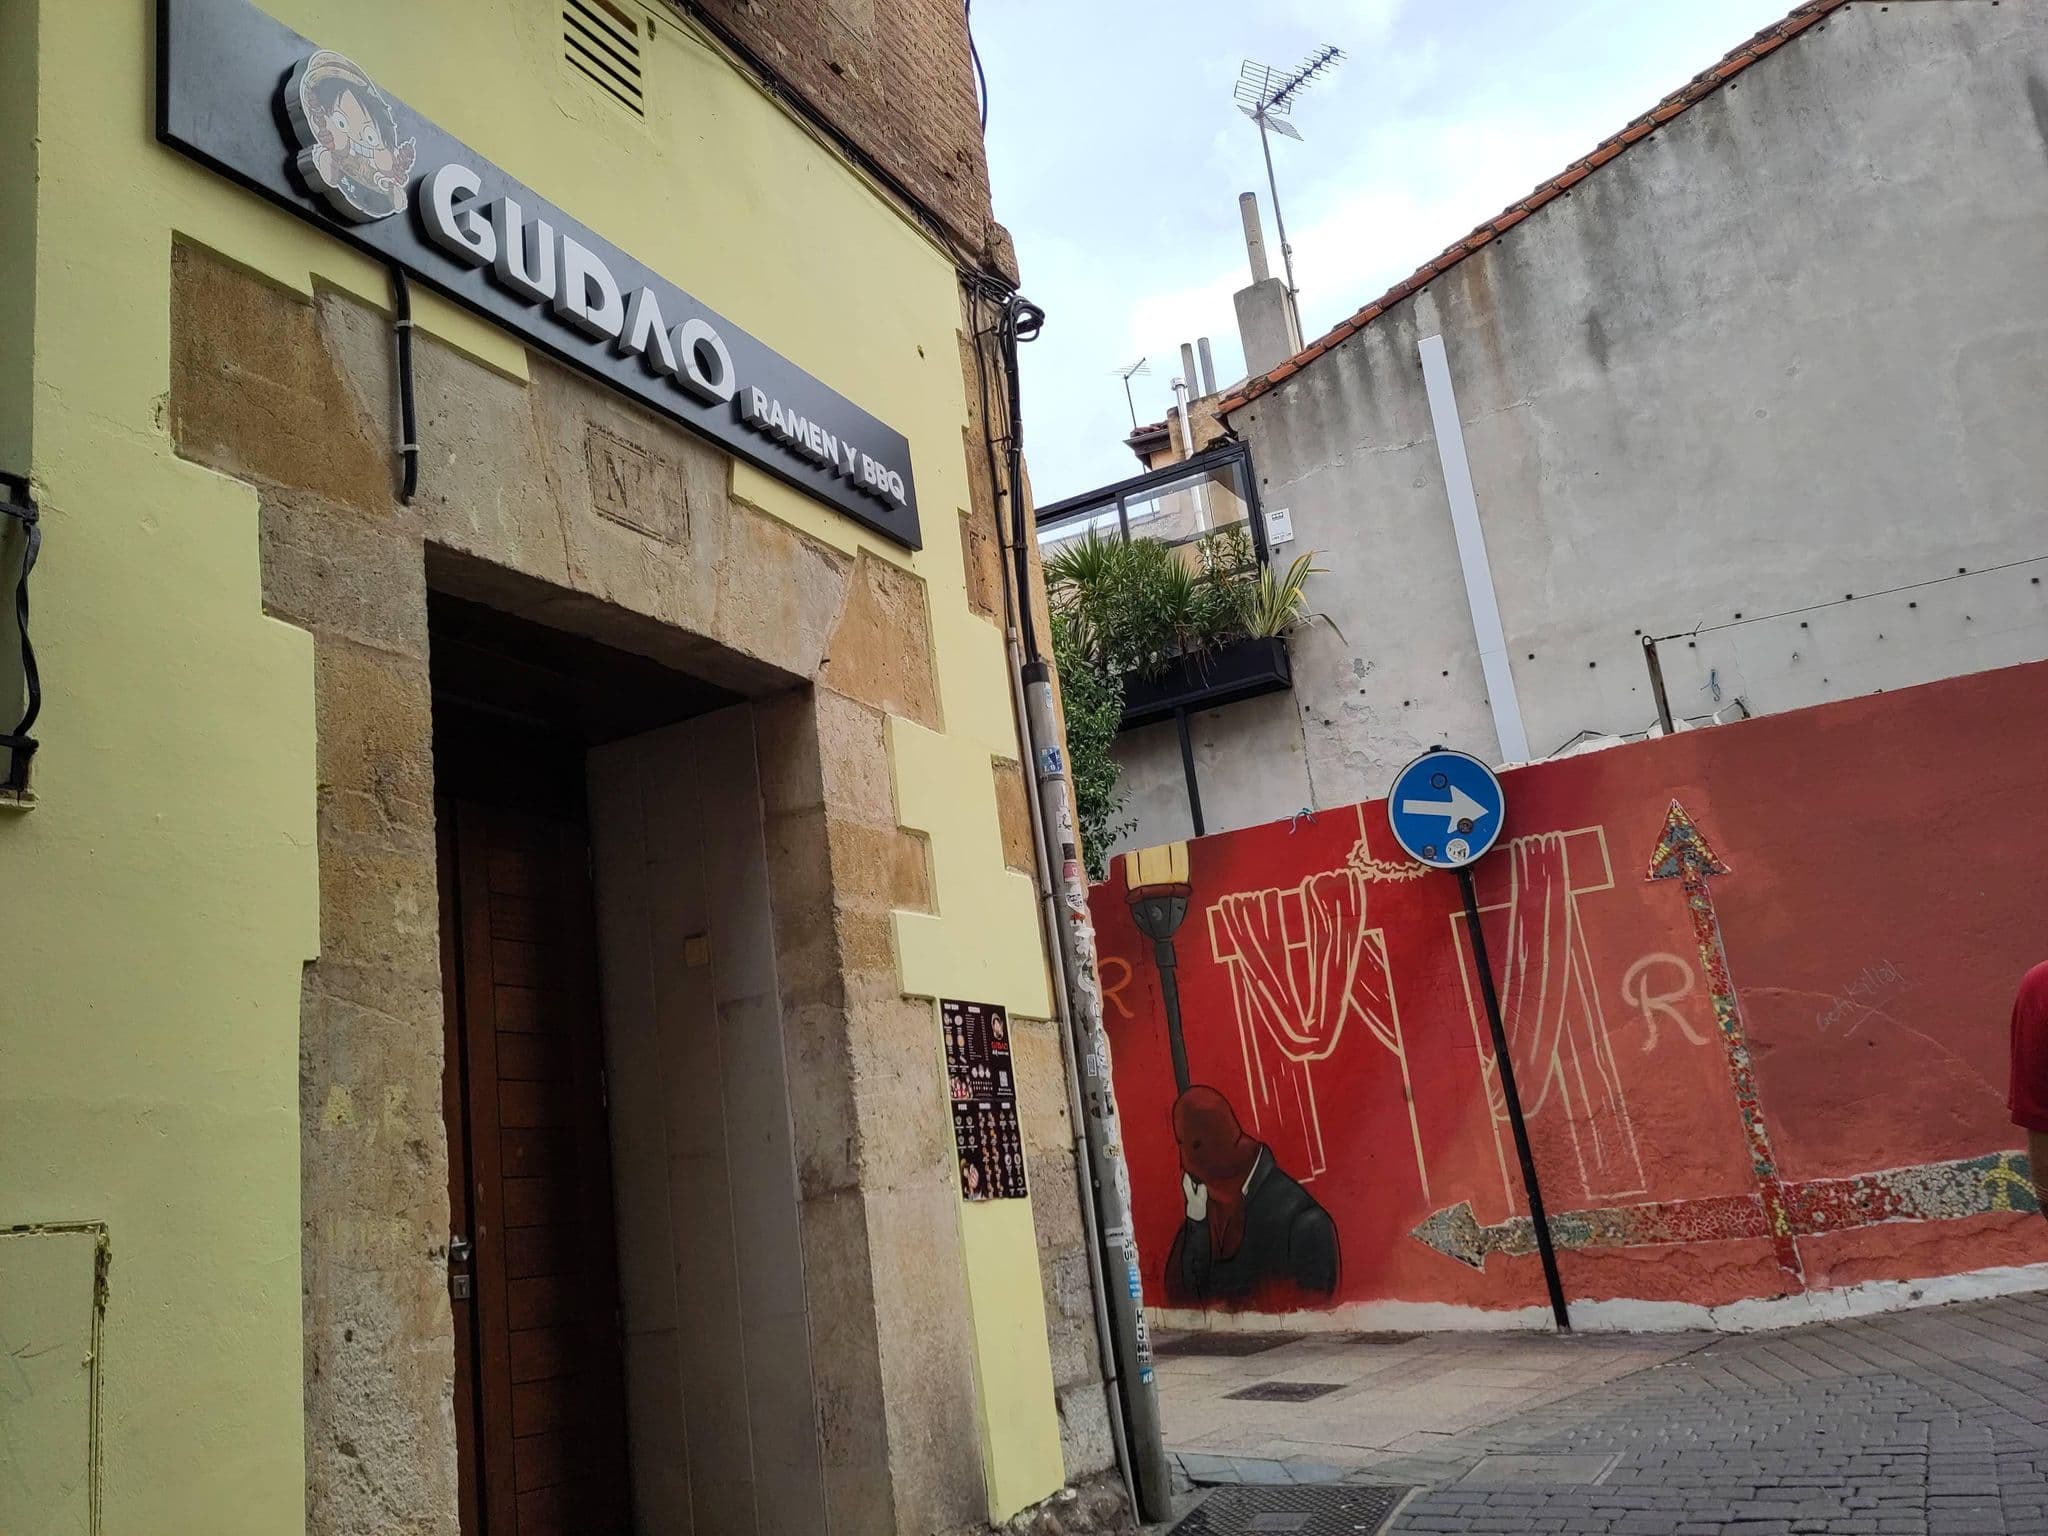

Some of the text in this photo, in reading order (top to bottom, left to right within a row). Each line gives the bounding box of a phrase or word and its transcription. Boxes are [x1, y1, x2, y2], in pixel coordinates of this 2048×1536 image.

[750, 384, 840, 466] RAMEN
[841, 440, 858, 475] Y
[860, 452, 908, 507] BBQ
[1622, 951, 1711, 1054] R
